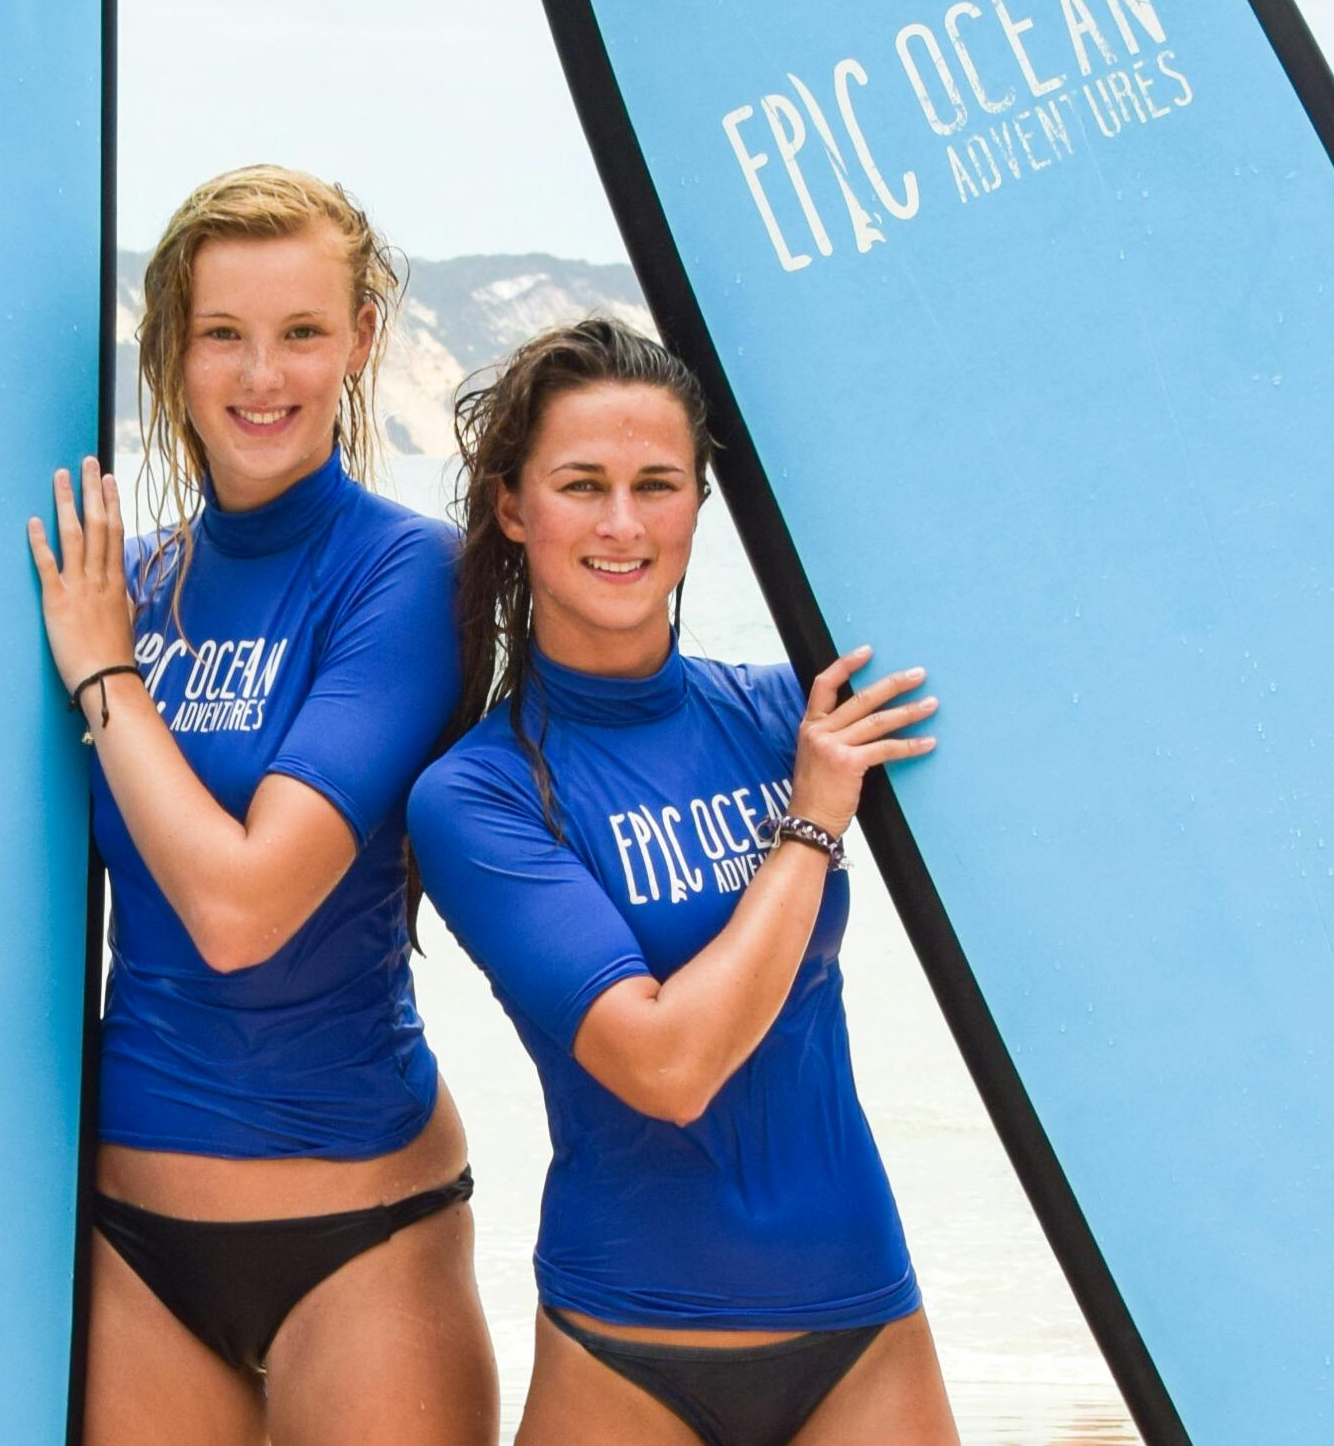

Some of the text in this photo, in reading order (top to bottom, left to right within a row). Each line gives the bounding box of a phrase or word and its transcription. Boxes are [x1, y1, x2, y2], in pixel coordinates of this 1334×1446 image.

[721, 58, 920, 273] EPIC
[184, 637, 288, 702] OCEAN
[609, 804, 703, 905] EPIC
